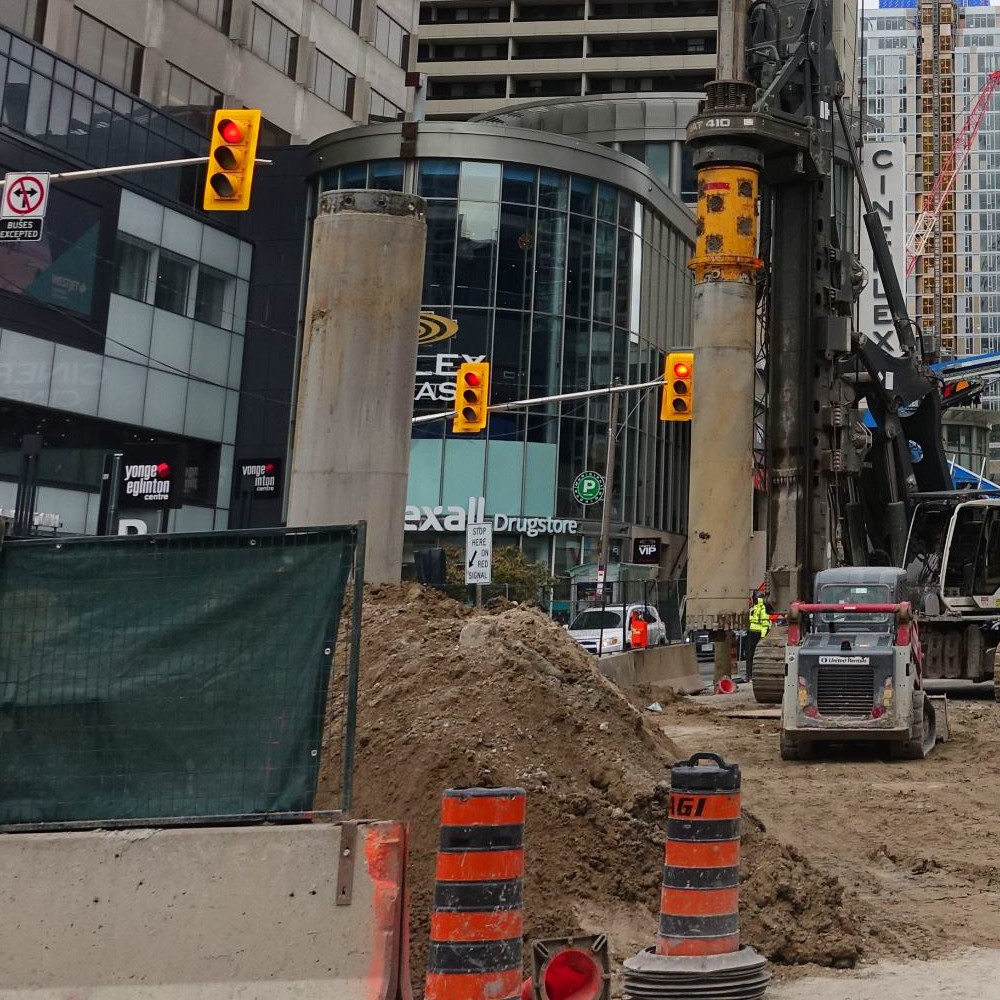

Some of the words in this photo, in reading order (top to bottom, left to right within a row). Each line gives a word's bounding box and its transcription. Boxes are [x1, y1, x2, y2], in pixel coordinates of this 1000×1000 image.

[705, 118, 731, 128] 410
[7, 221, 33, 229] BUSES
[0, 230, 38, 238] EXCEPTED
[124, 464, 157, 481] yonge
[126, 479, 170, 497] eglinton
[144, 493, 169, 501] centre
[493, 513, 578, 538] Drugstore
[472, 528, 487, 536] STOP
[638, 547, 657, 556] VIP
[477, 560, 489, 568] RED
[468, 571, 488, 580] SIGNAL
